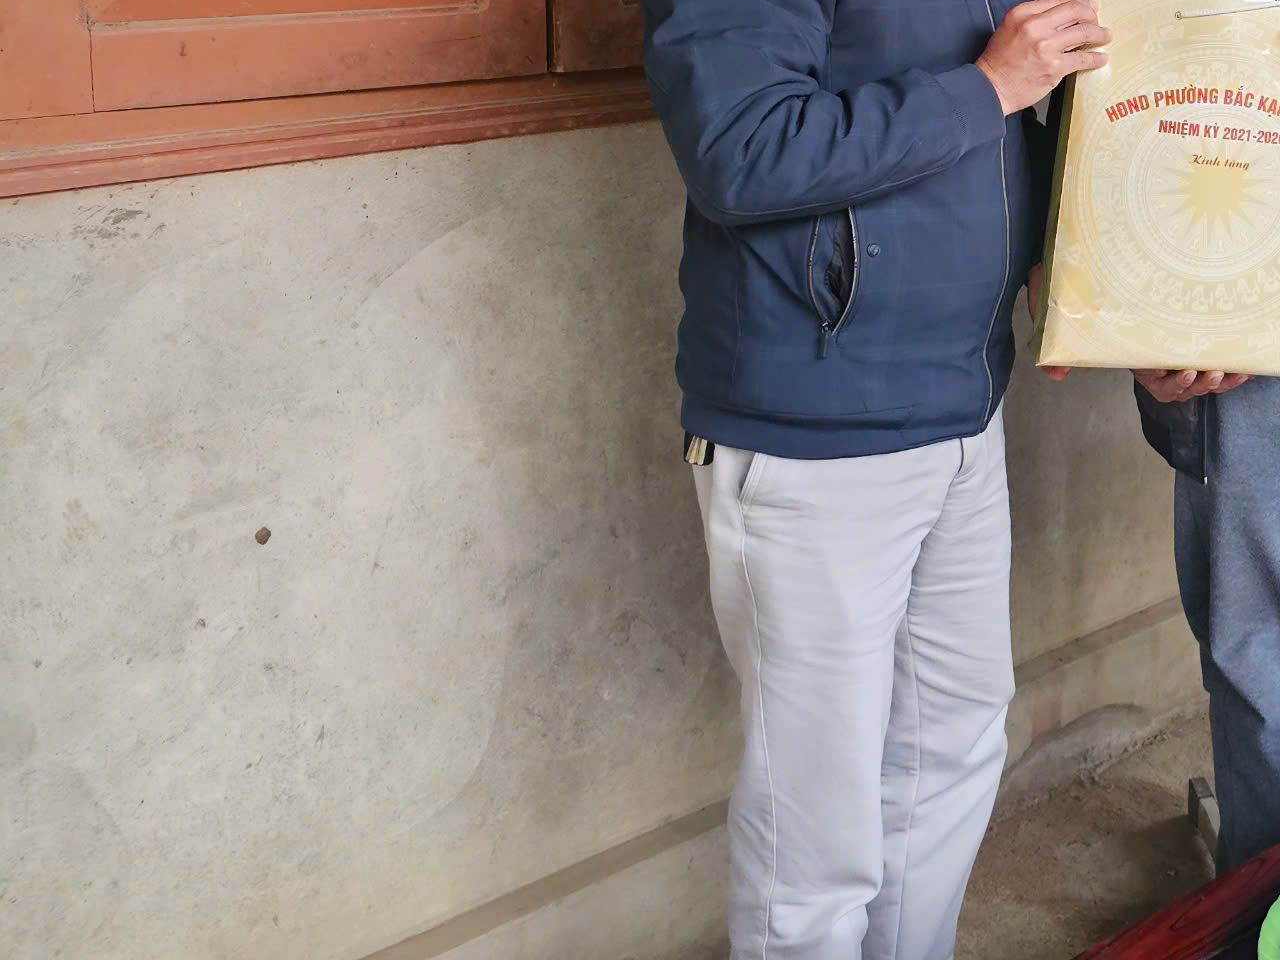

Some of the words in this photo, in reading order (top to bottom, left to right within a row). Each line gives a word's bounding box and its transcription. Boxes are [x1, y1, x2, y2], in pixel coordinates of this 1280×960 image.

[1105, 95, 1150, 123] HĐND
[1153, 84, 1219, 108] PHƯỜNG
[1223, 85, 1255, 109] BẮC
[1158, 119, 1200, 139] NHIỆM
